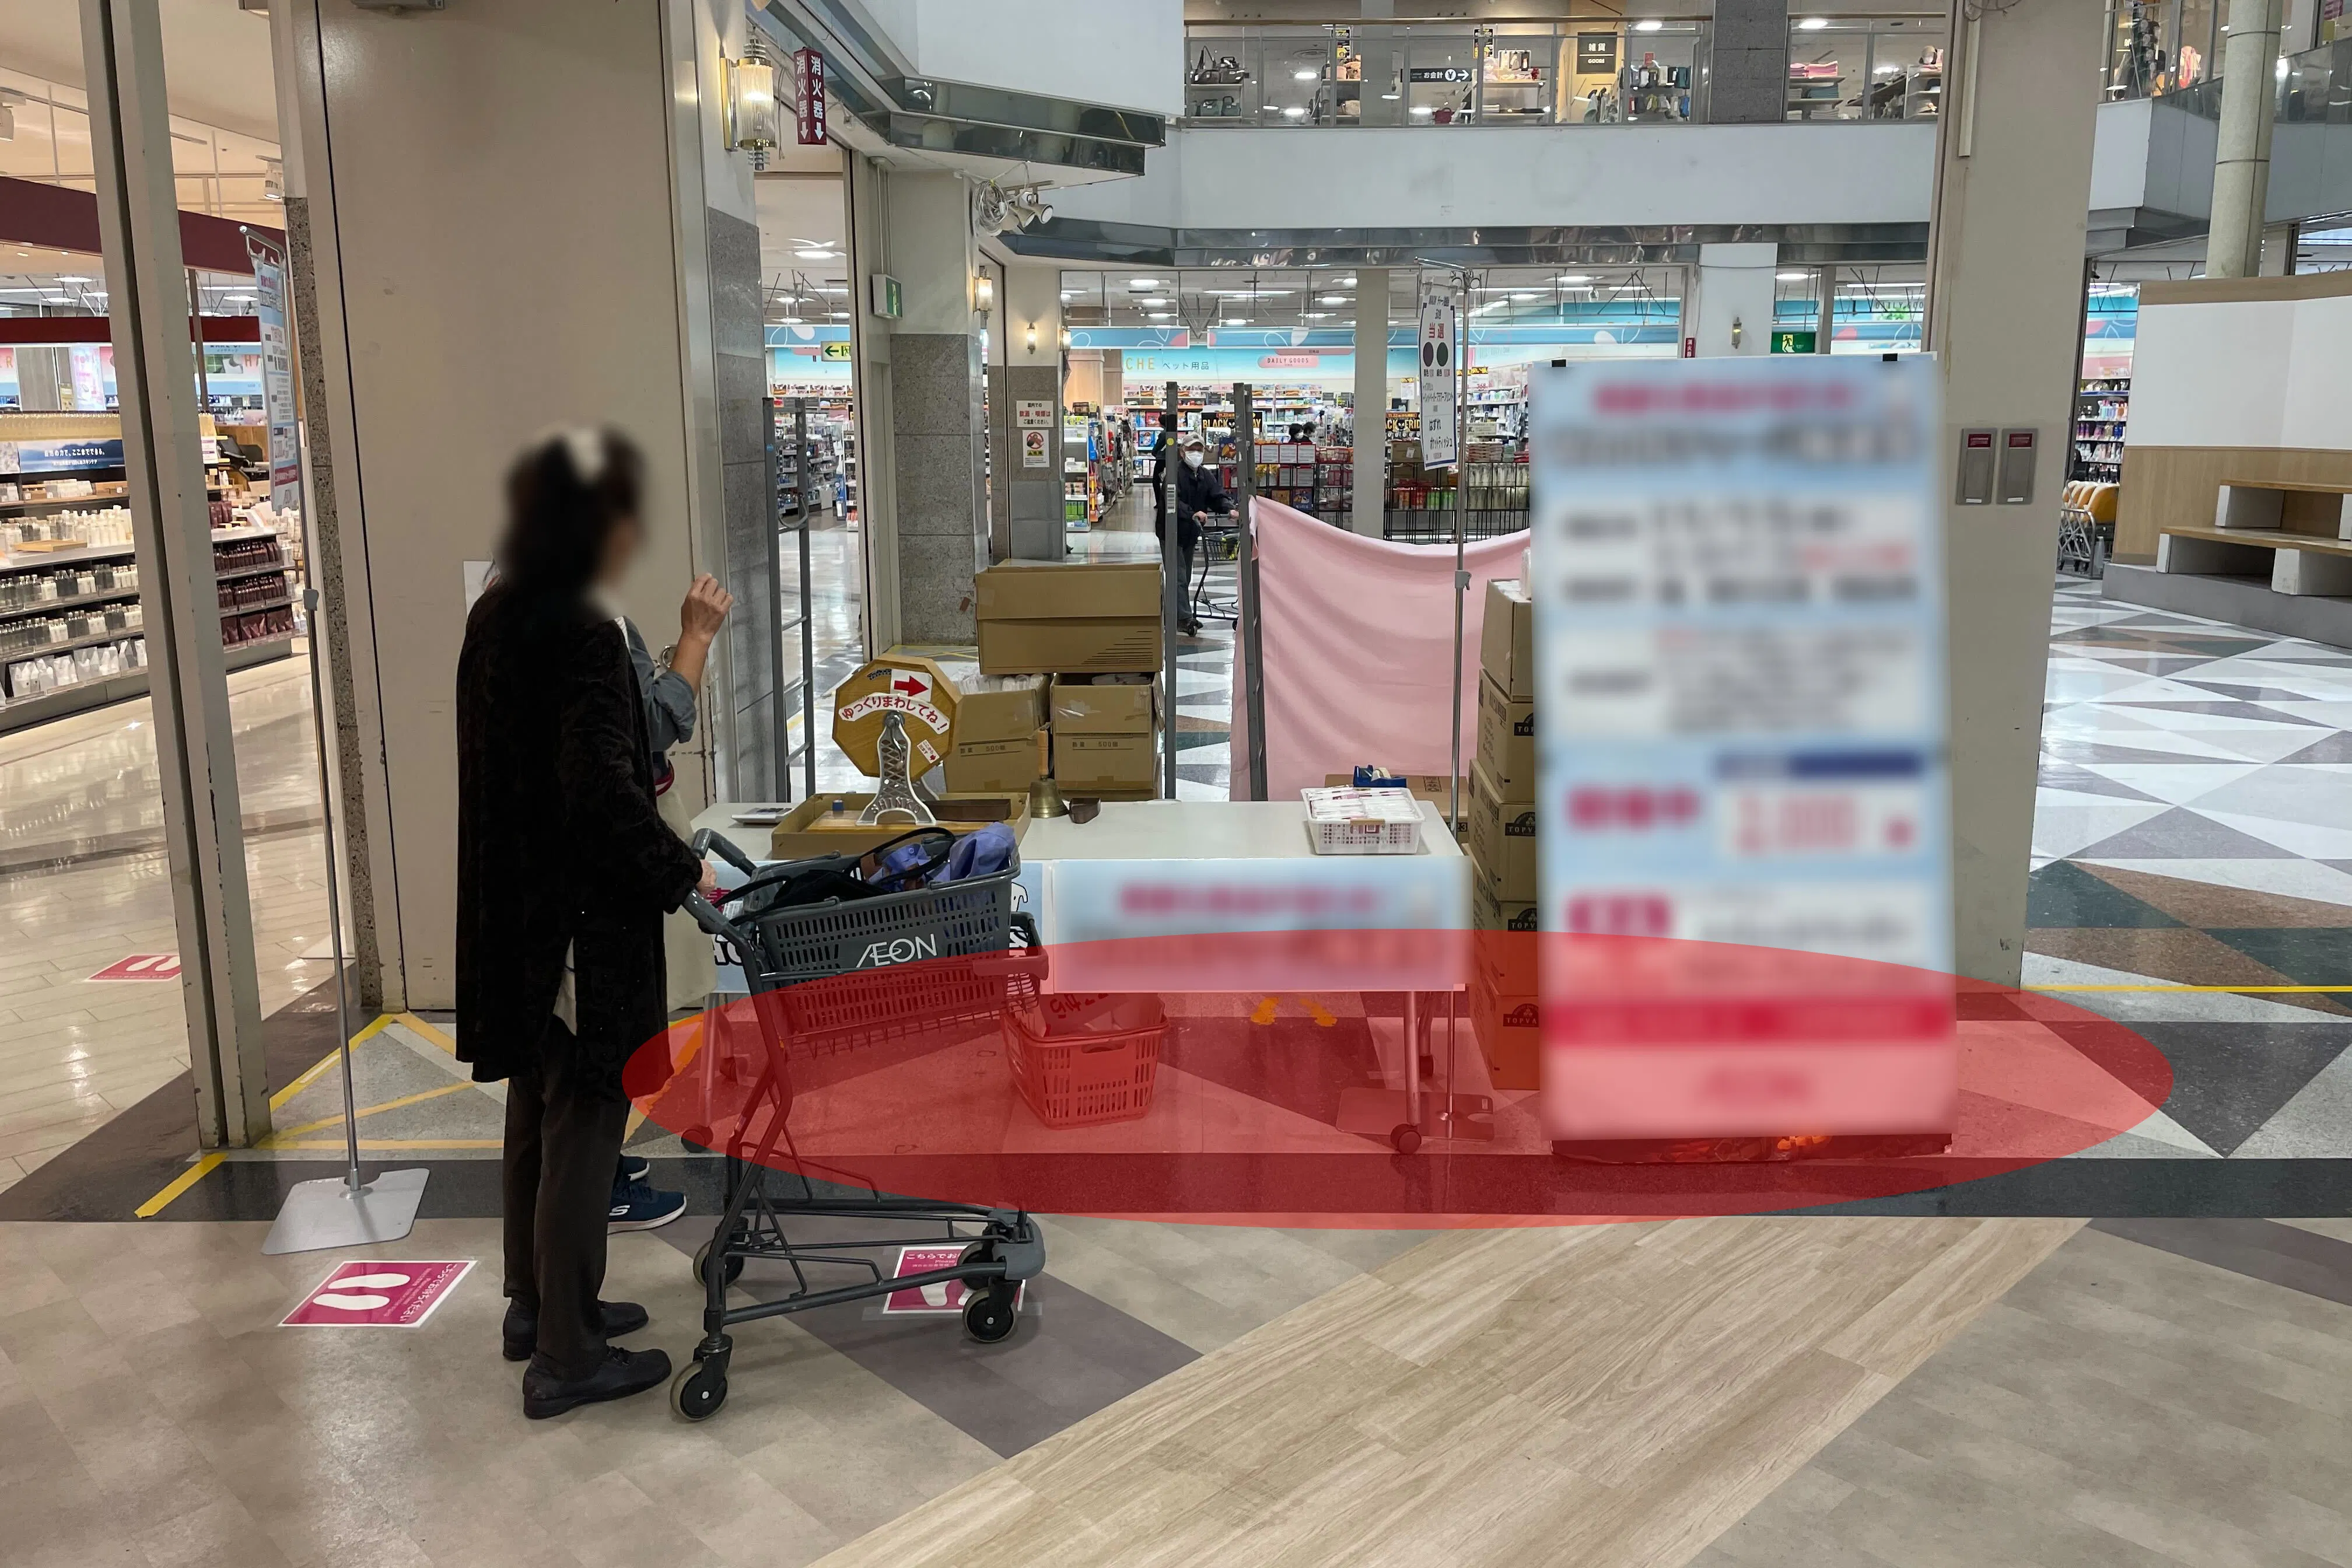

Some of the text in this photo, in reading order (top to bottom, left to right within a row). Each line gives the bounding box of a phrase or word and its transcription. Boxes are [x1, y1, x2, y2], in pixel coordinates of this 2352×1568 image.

[1588, 43, 1606, 51] 雑貨
[1423, 71, 1443, 79] お会計
[796, 55, 808, 118] 消火器
[811, 55, 823, 119] 消火器
[1429, 321, 1444, 339] 当選
[1161, 361, 1210, 370] ペット用品
[1429, 418, 1441, 432] はずれ
[1508, 825, 1536, 834] TOPV
